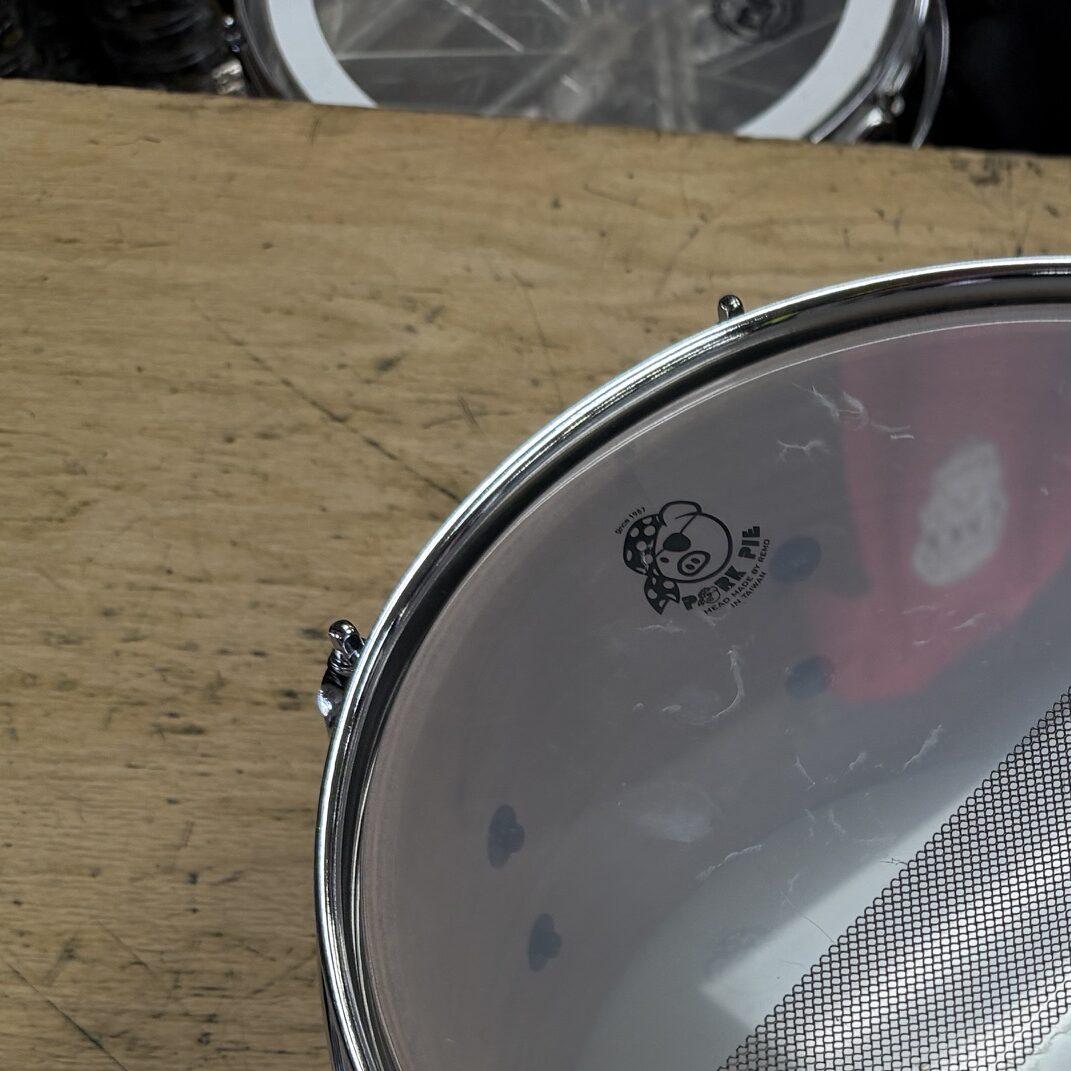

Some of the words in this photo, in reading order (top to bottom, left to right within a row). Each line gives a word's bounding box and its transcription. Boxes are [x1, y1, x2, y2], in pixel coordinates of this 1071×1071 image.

[738, 525, 760, 559] PIE
[704, 596, 730, 615] HEAD
[731, 576, 754, 597] MADE
[751, 563, 761, 575] BY
[757, 539, 770, 562] REMO
[730, 597, 741, 608] IN
[742, 571, 766, 599] TAIWAN
